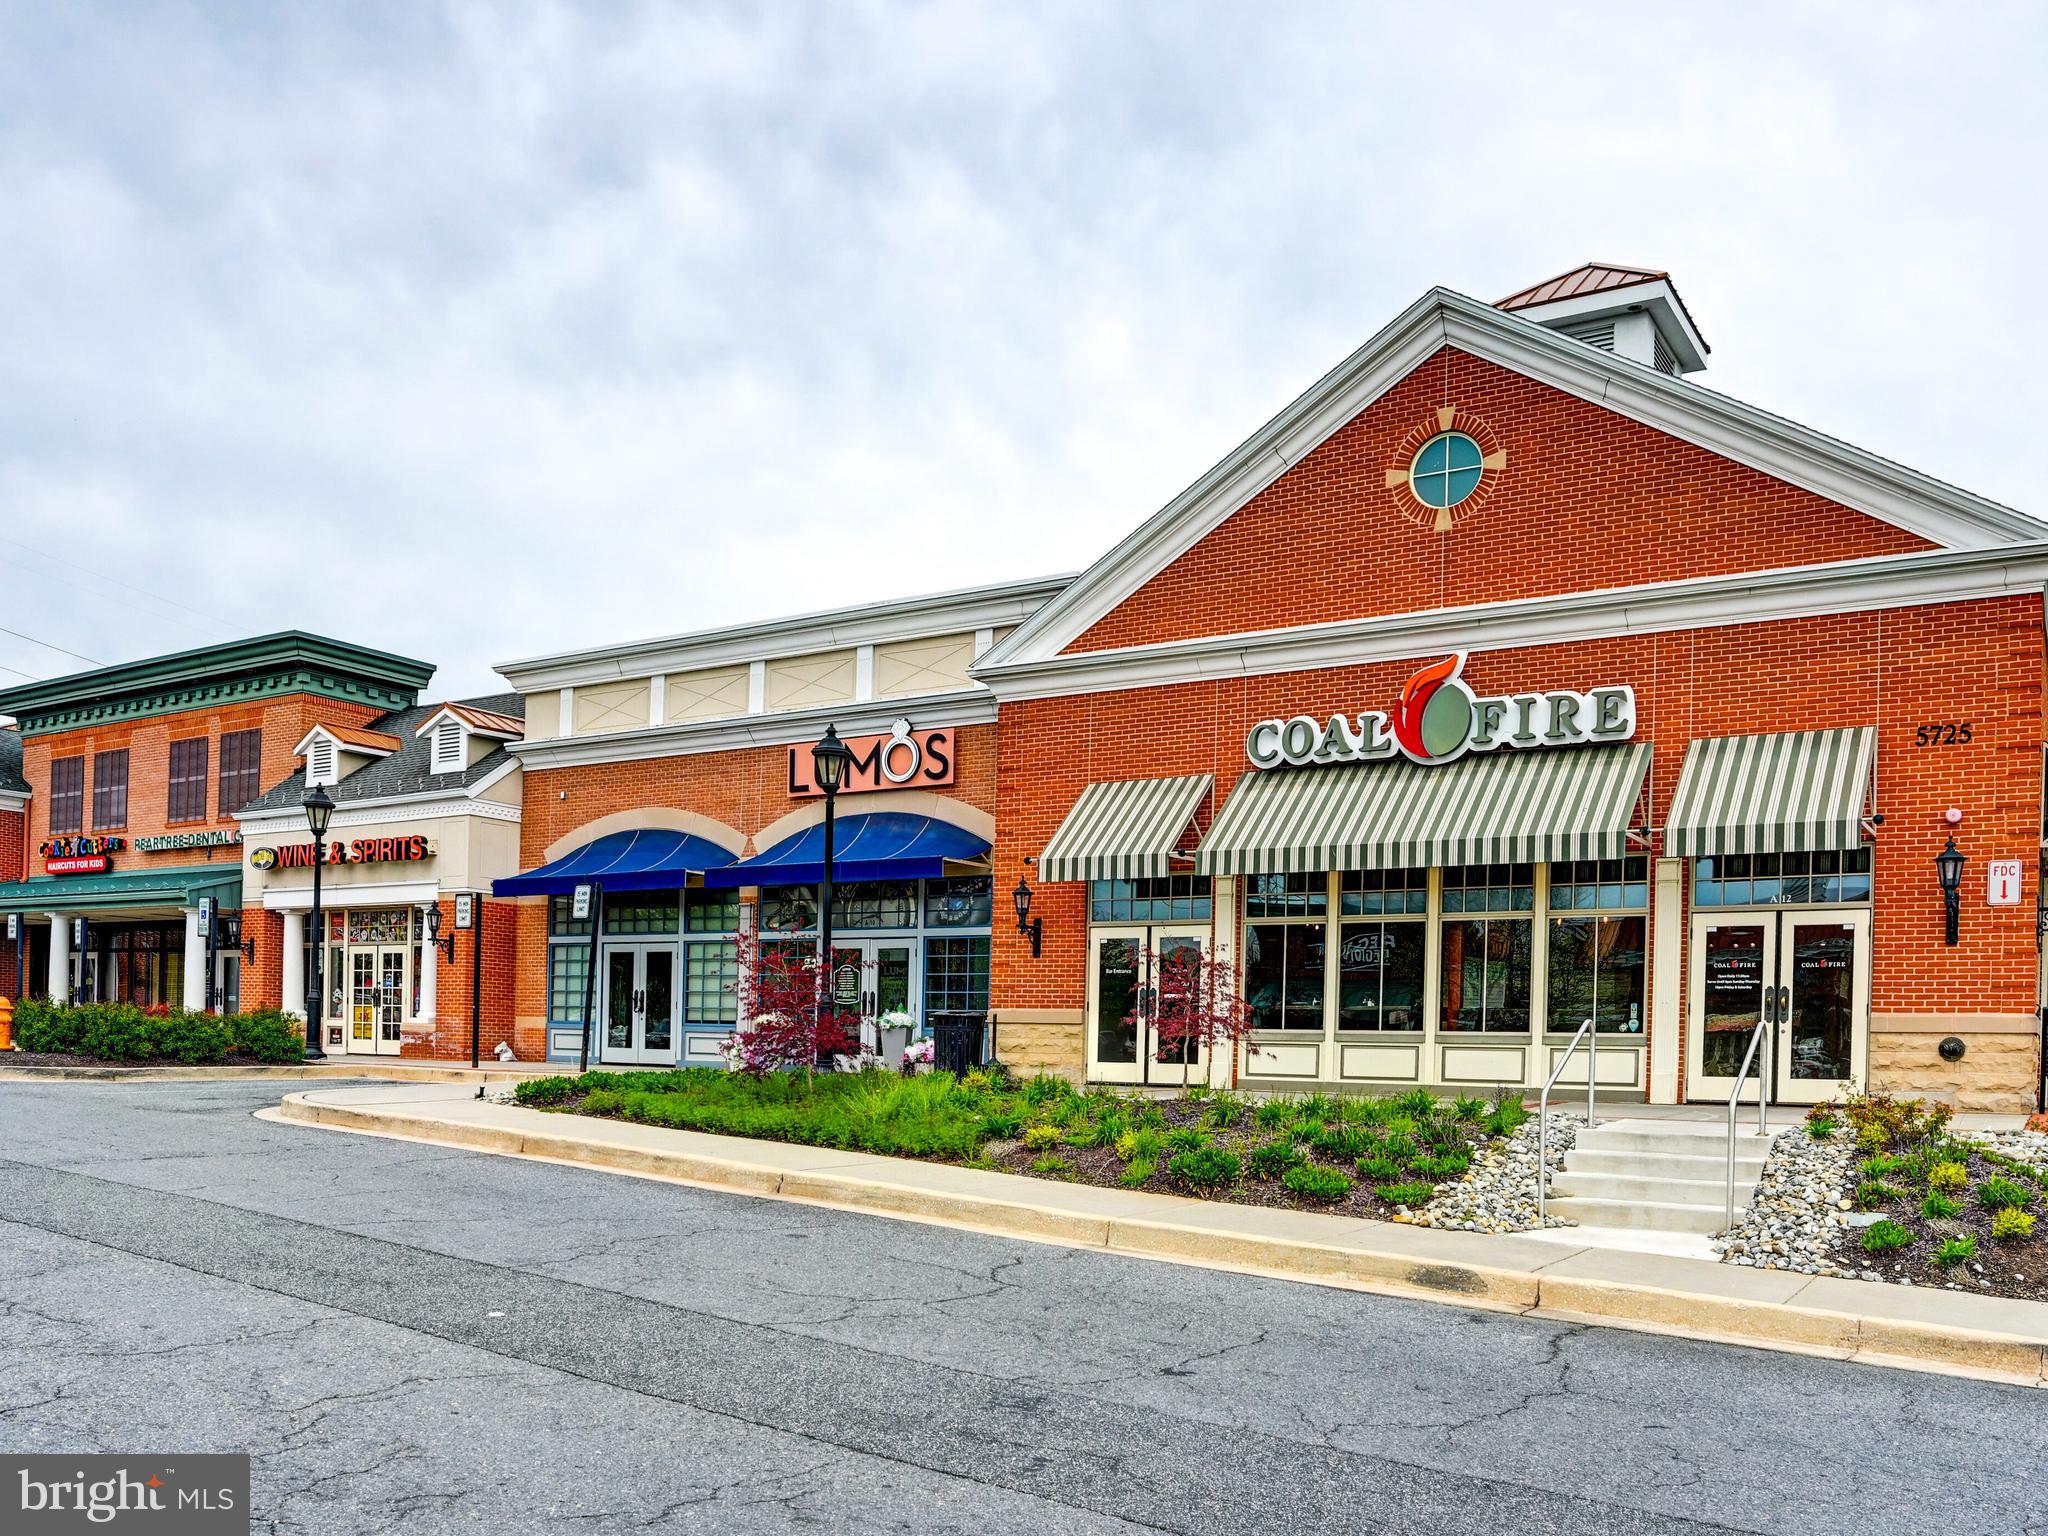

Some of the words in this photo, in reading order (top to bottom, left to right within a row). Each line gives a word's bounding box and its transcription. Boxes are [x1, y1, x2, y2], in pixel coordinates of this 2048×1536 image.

[1250, 713, 1393, 762] COAL
[1470, 689, 1630, 744] FIRE
[1915, 722, 1973, 747] 5725
[80, 836, 118, 855] Cutters
[187, 830, 230, 847] DENTAL
[277, 842, 322, 868] WINE
[329, 841, 342, 865] &
[351, 835, 424, 864] SPIRITS
[47, 861, 76, 871] HAIRCUTS
[76, 860, 89, 869] FOR
[89, 859, 104, 869] KIDS
[1993, 865, 2016, 877] FDC
[1769, 895, 1778, 903] A
[1781, 894, 1792, 903] 12
